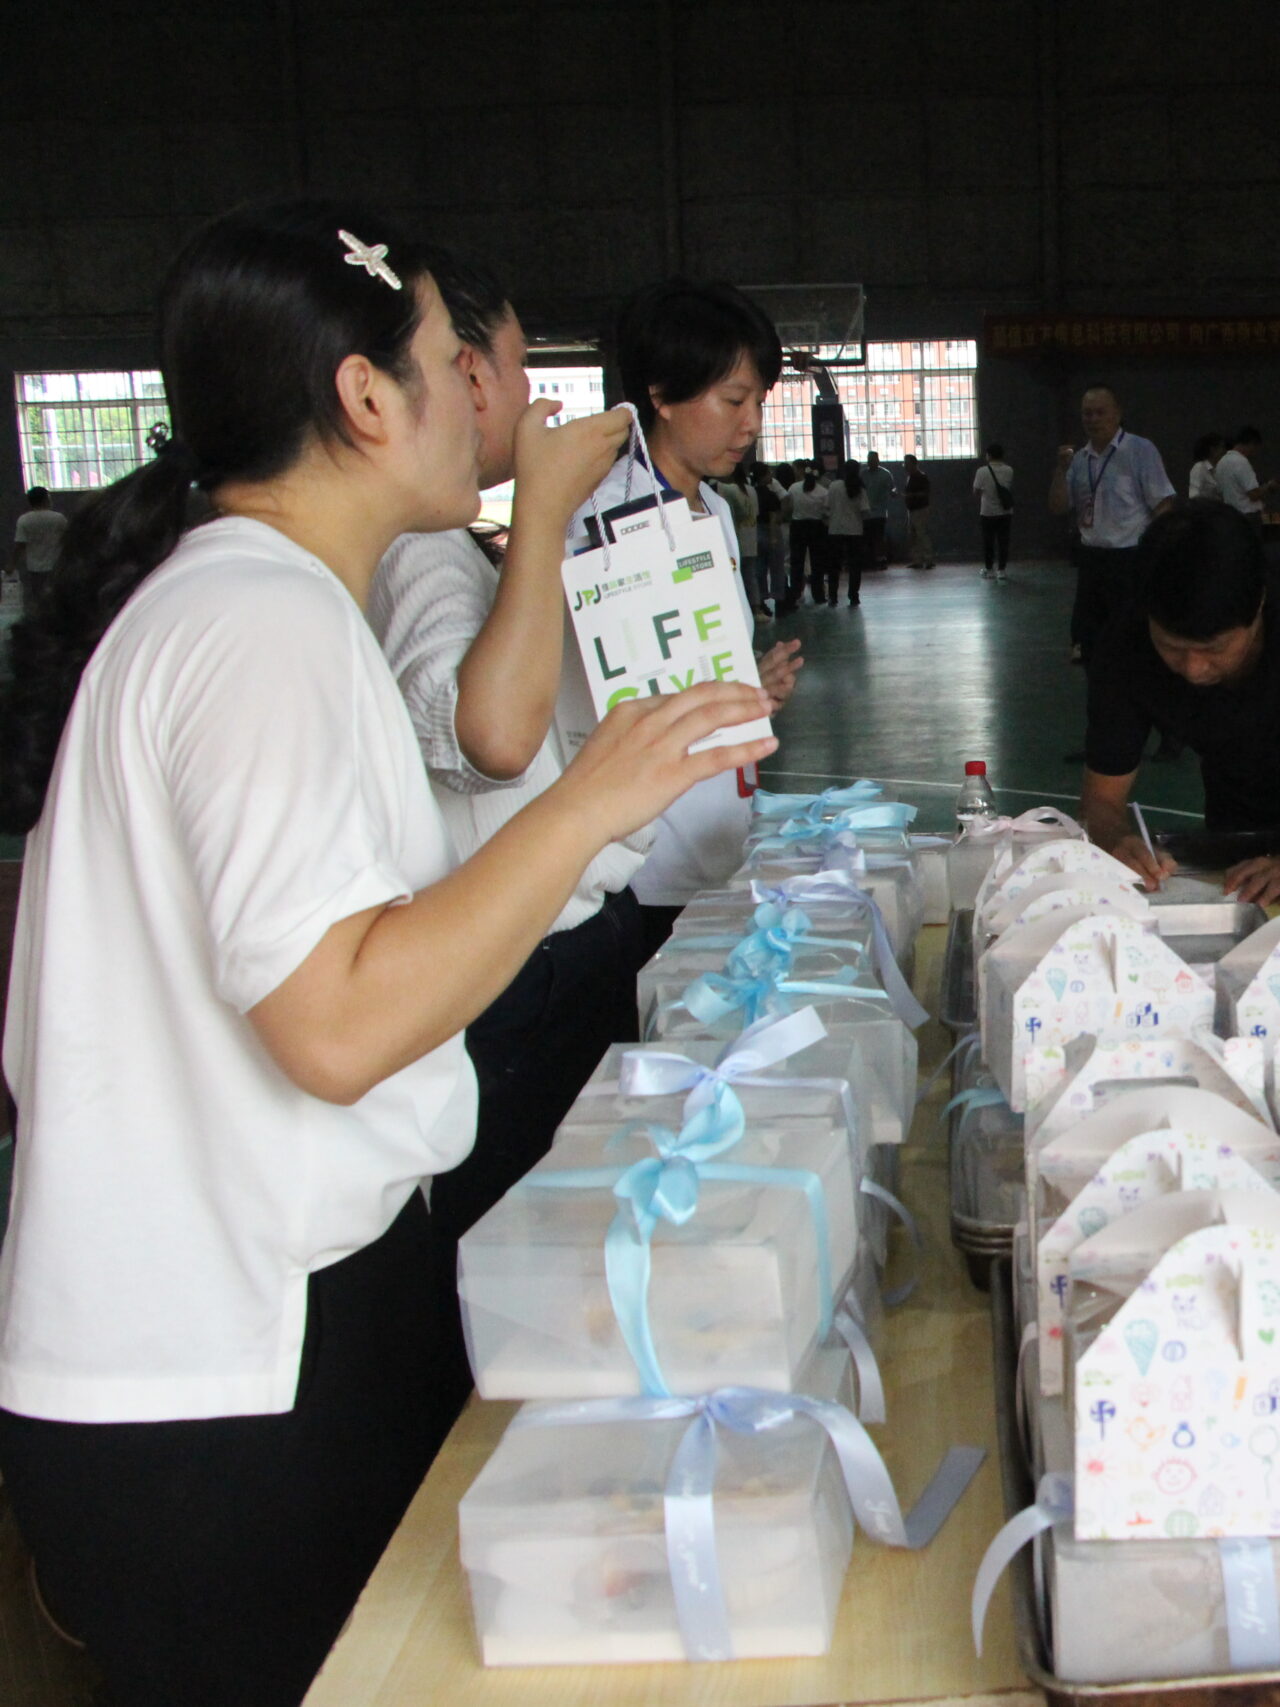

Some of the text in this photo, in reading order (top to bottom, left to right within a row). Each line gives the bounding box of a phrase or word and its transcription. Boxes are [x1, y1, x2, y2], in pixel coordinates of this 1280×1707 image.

[678, 553, 713, 569] LIFESTYLE
[691, 561, 714, 573] STORE
[574, 584, 602, 611] JPJ
